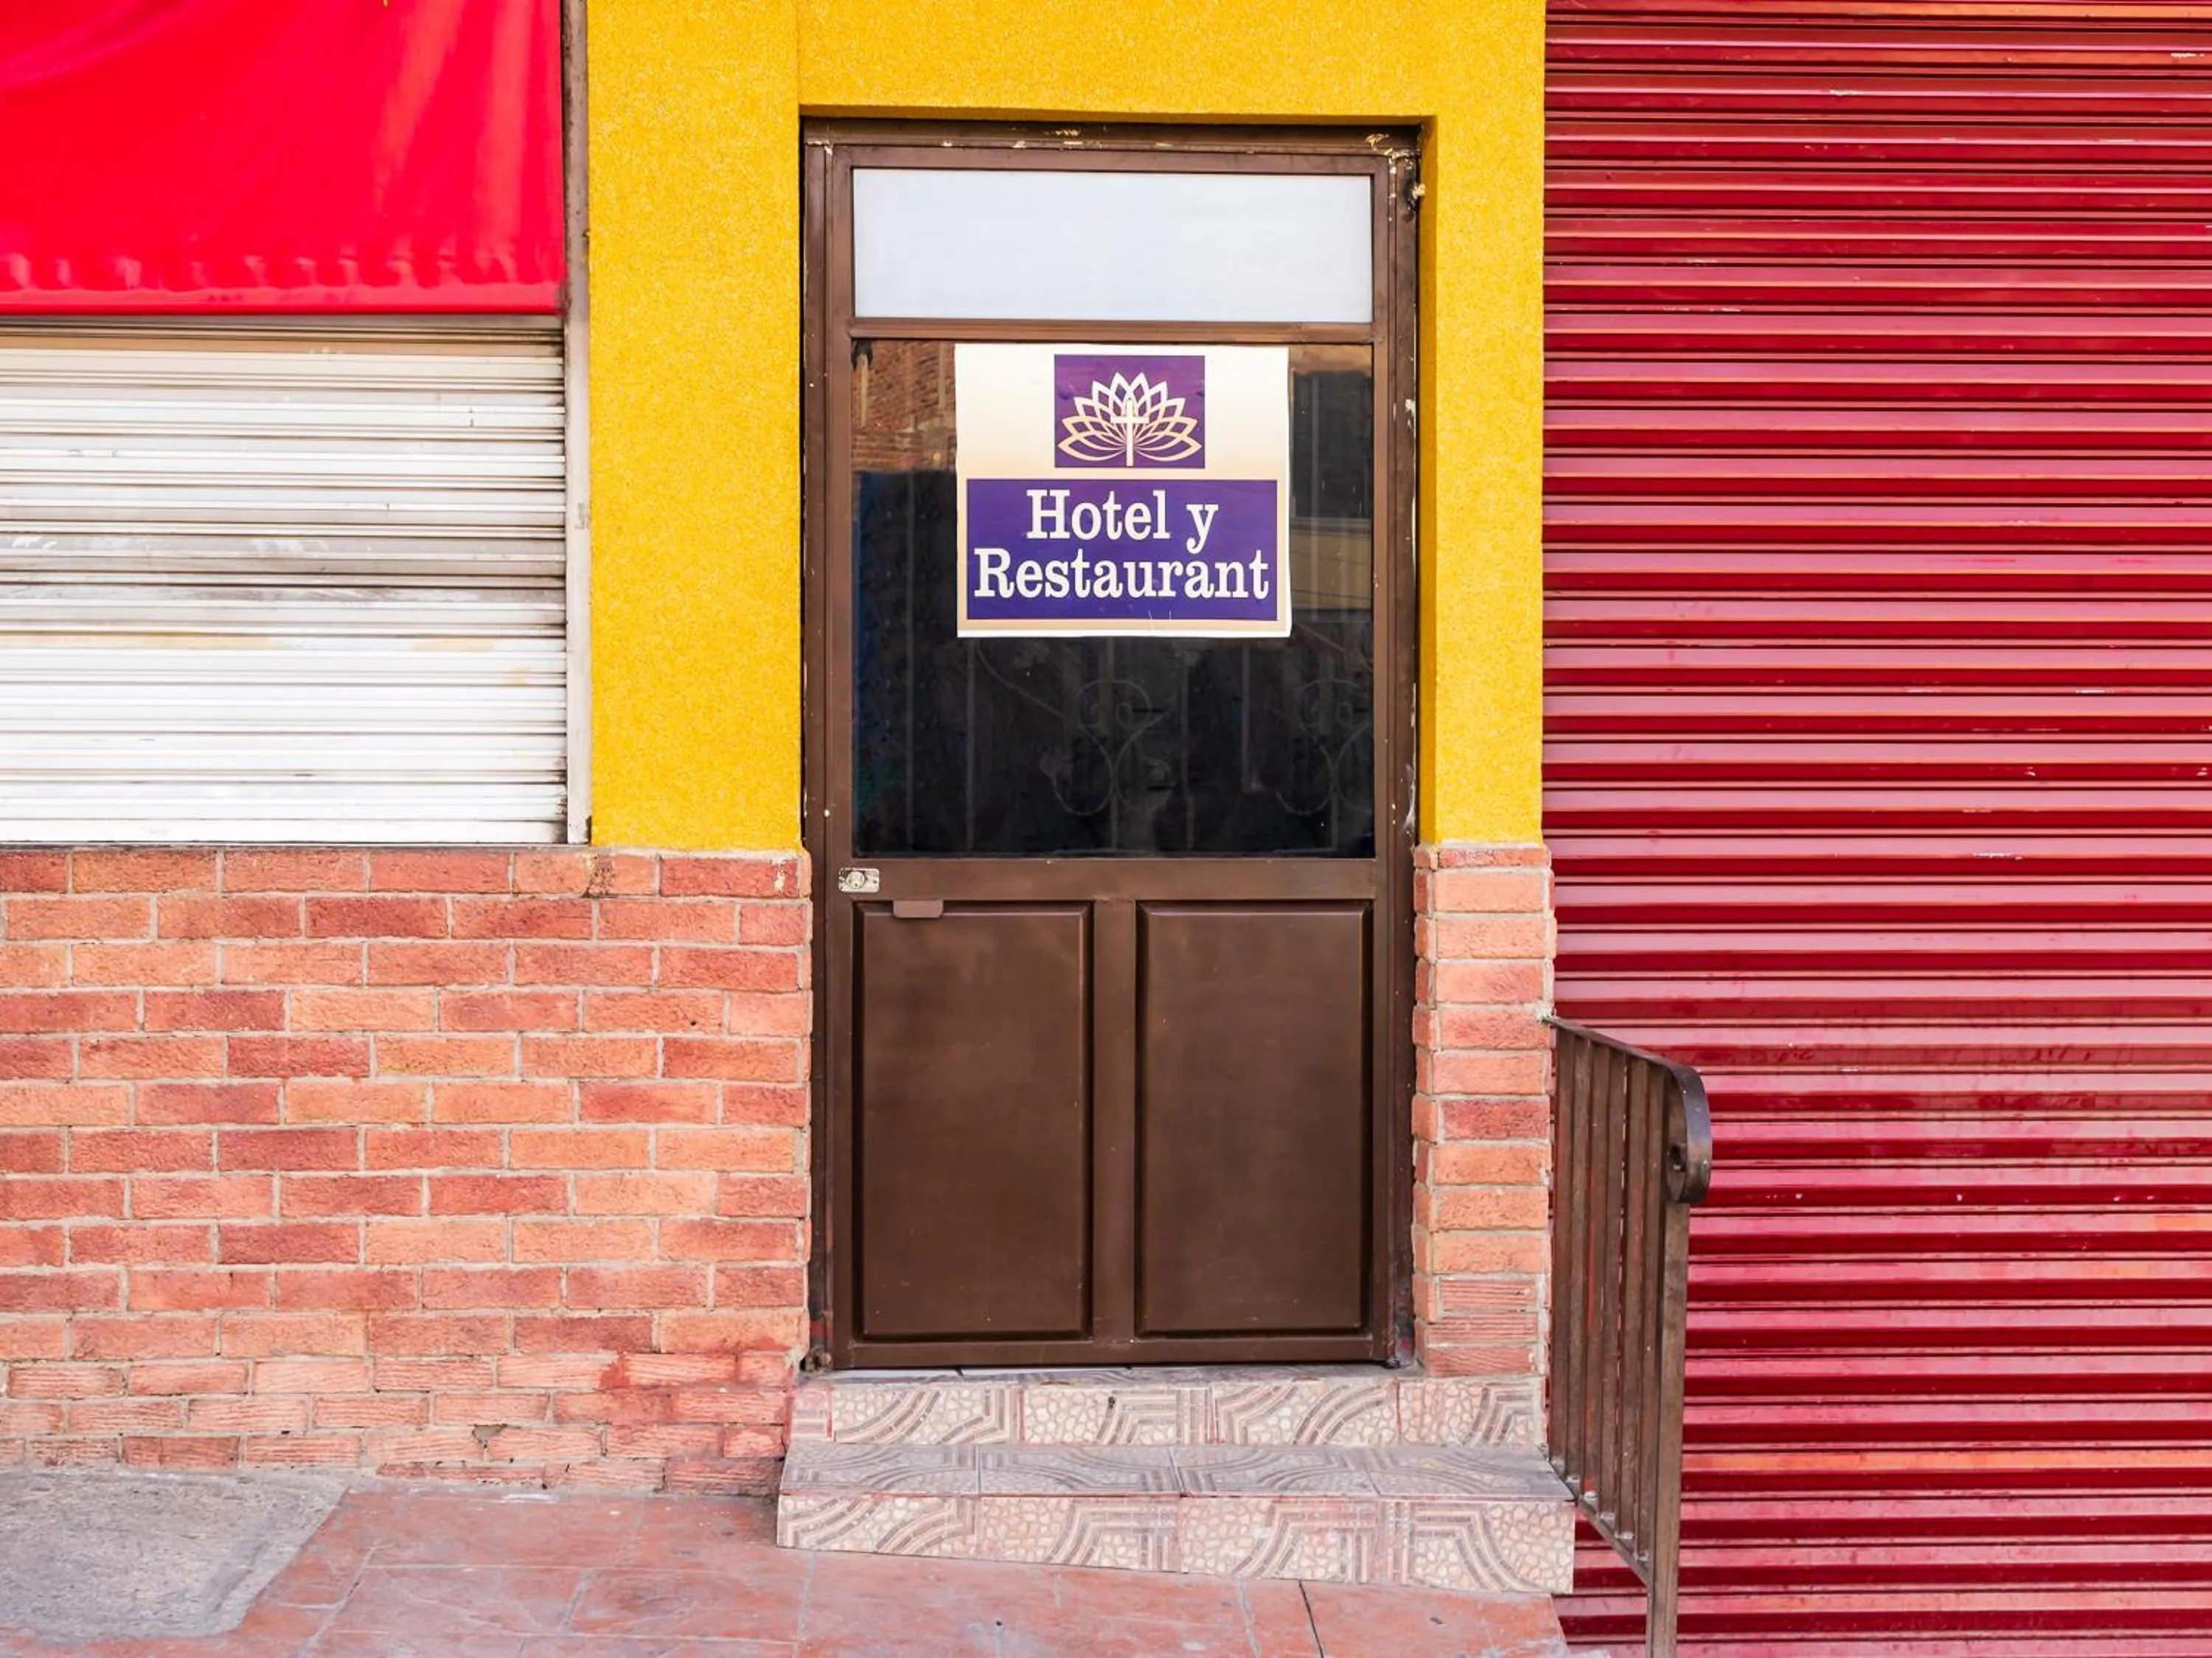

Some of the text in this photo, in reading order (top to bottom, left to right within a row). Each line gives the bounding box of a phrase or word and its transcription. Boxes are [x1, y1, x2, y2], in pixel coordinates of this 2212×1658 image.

[1026, 489, 1219, 555] Hotel y
[974, 548, 1270, 600] Restaurant
